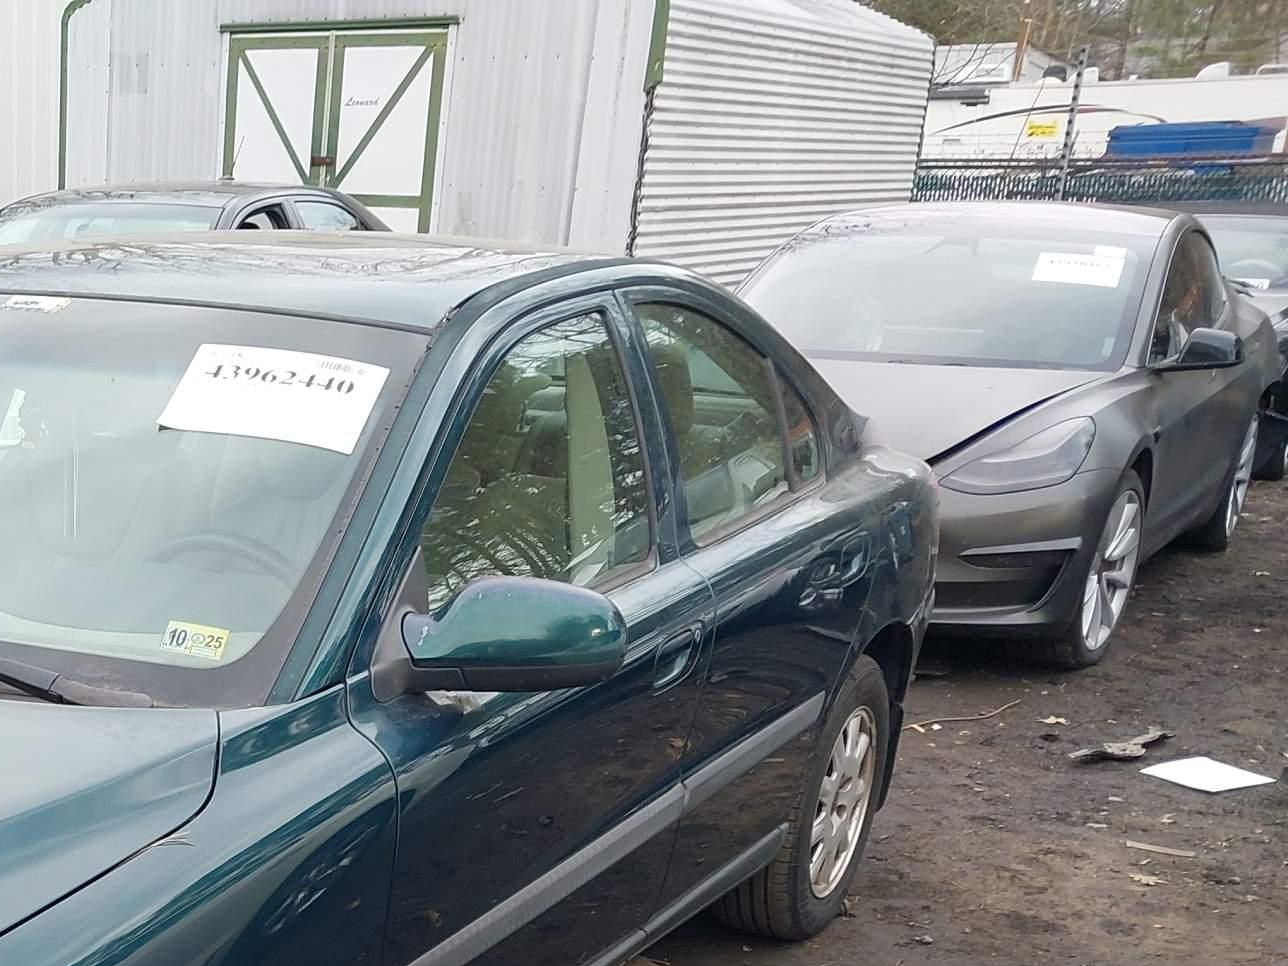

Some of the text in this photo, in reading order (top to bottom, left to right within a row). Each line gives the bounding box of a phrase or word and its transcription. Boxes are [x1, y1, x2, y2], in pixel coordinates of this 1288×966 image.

[344, 96, 379, 107] Leonard
[205, 363, 355, 394] 43962440
[168, 627, 224, 649] 10 25
